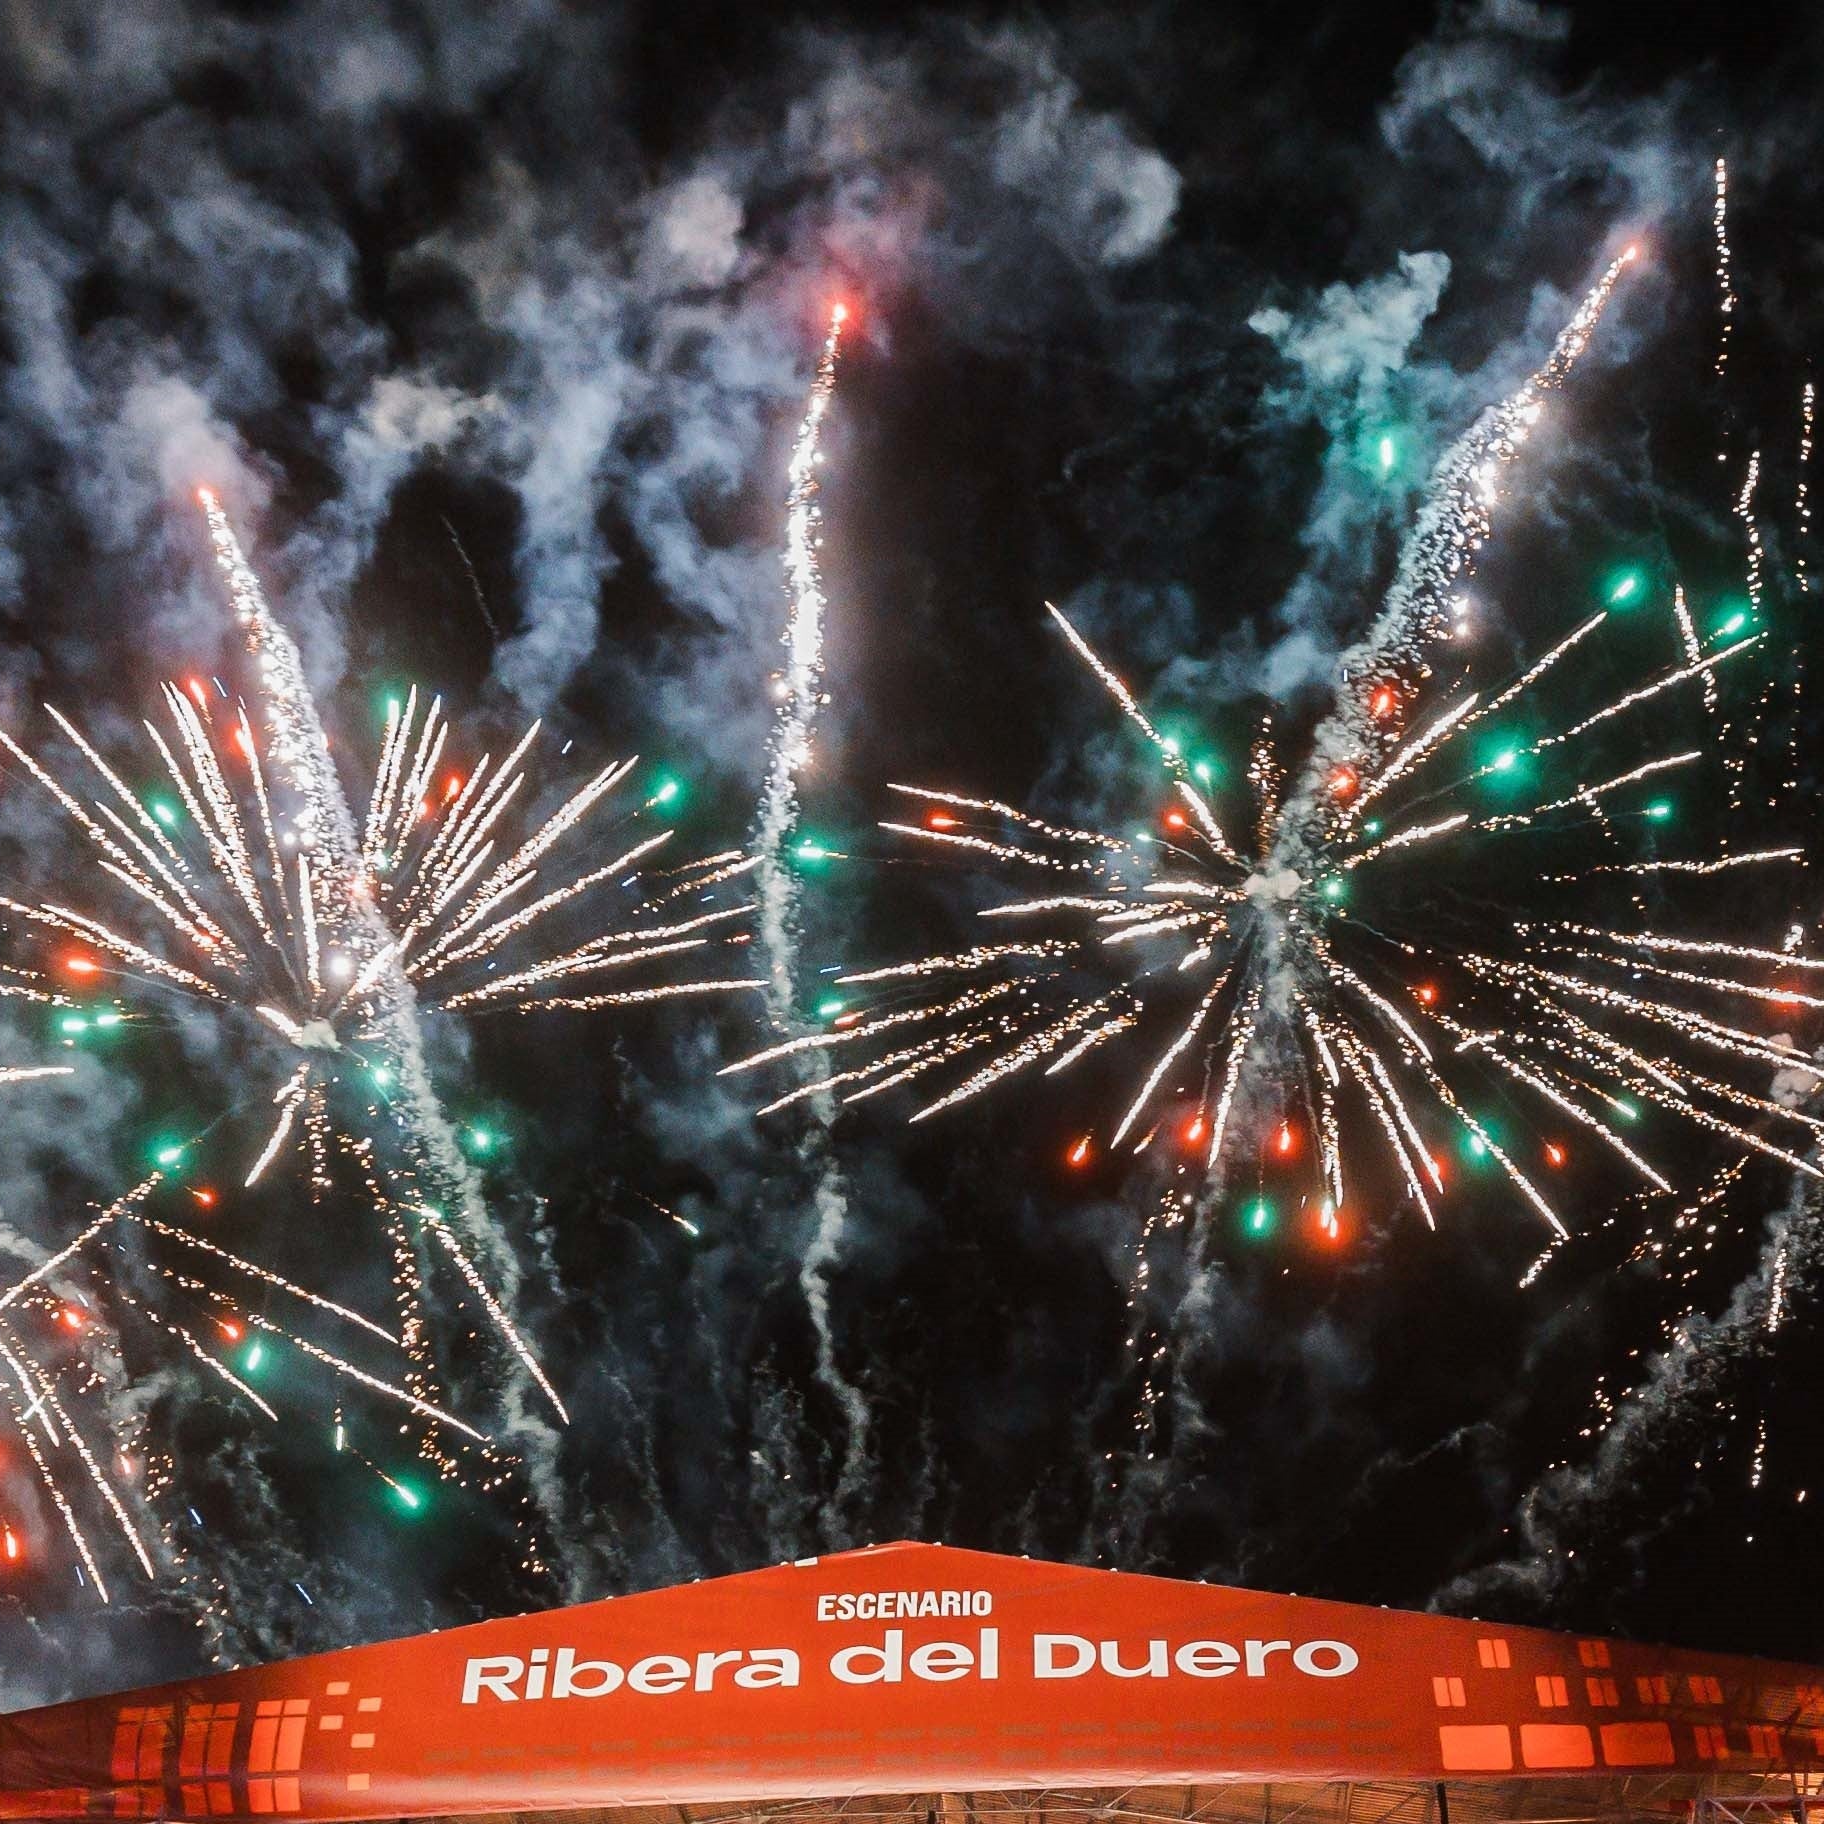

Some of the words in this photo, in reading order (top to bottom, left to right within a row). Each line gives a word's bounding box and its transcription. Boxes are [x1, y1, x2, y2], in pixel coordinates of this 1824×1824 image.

[817, 1590, 993, 1621] ESCENARIO
[461, 1647, 801, 1704] Ribera
[829, 1627, 999, 1684] del
[1033, 1634, 1360, 1679] Duero
